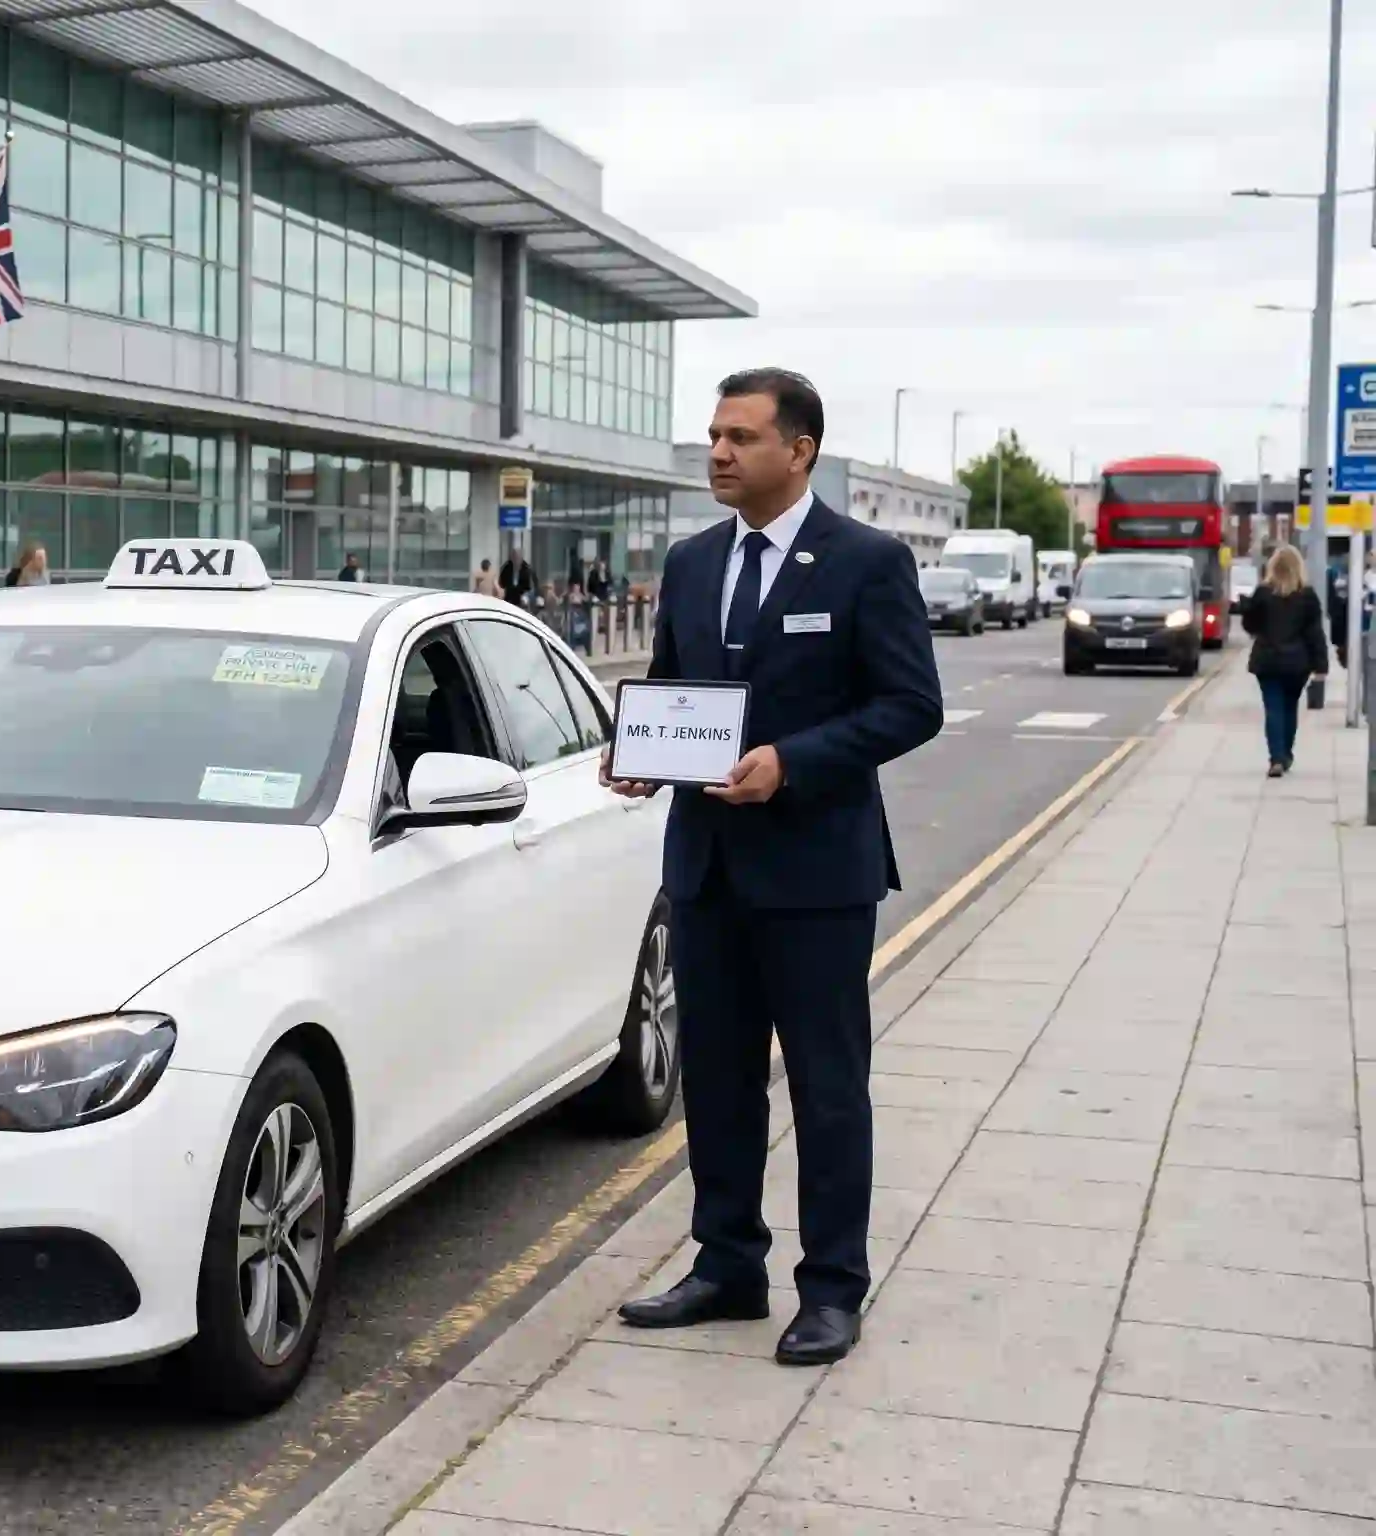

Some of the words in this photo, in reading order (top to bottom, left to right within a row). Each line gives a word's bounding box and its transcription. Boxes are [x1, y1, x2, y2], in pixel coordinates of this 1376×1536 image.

[129, 548, 235, 576] TAXI
[627, 724, 653, 738] MR.
[658, 726, 667, 738] T.
[672, 726, 731, 740] JENKINS
